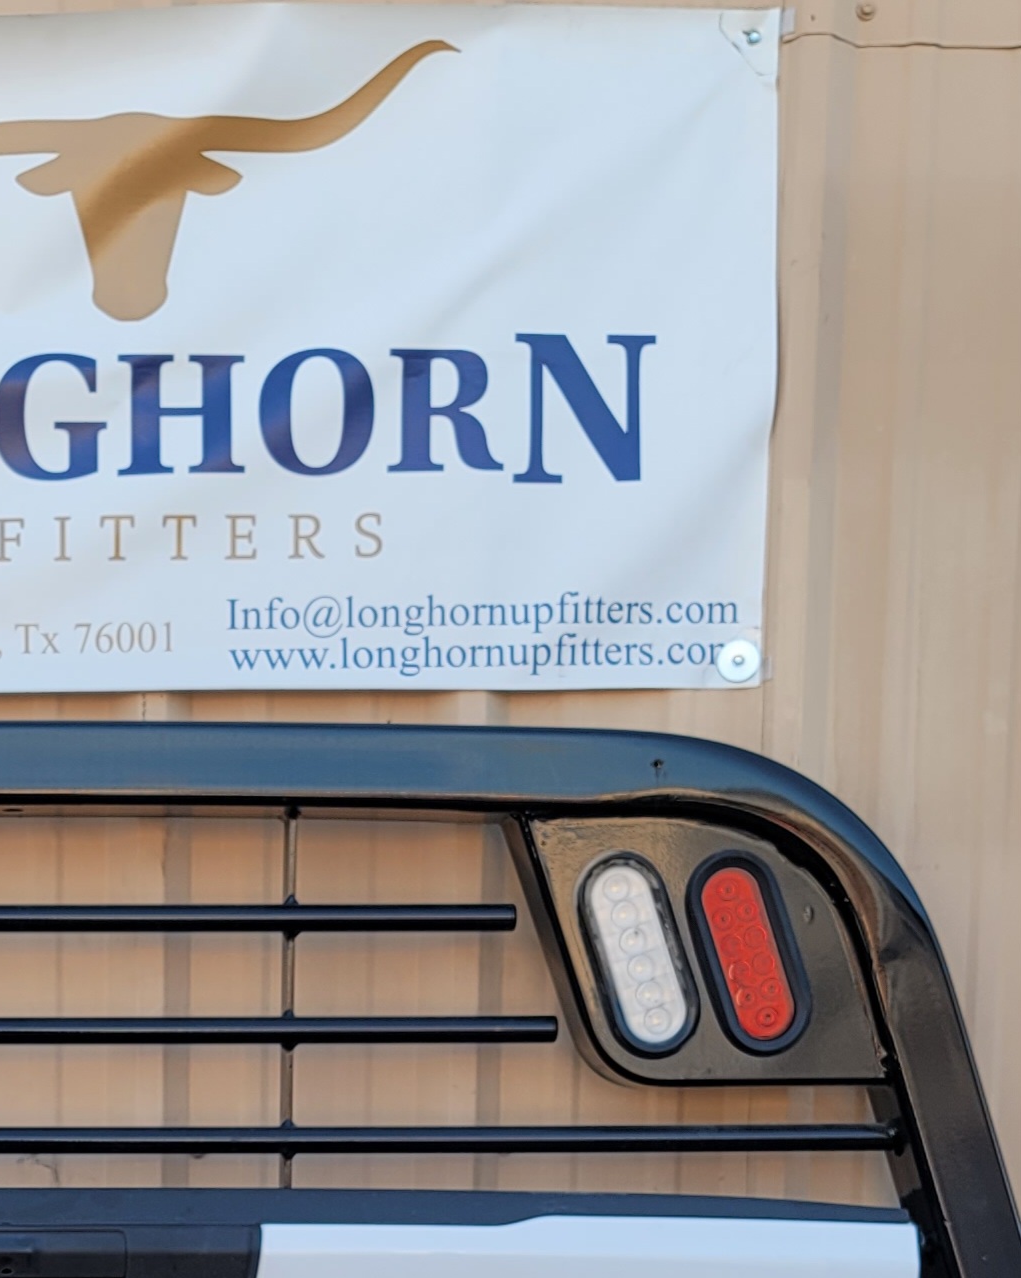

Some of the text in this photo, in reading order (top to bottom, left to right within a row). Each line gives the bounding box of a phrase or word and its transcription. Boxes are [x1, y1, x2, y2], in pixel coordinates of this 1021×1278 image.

[226, 591, 739, 639] Info@longhornupfitters.com
[14, 622, 61, 655] Tx
[74, 621, 175, 654] 76001
